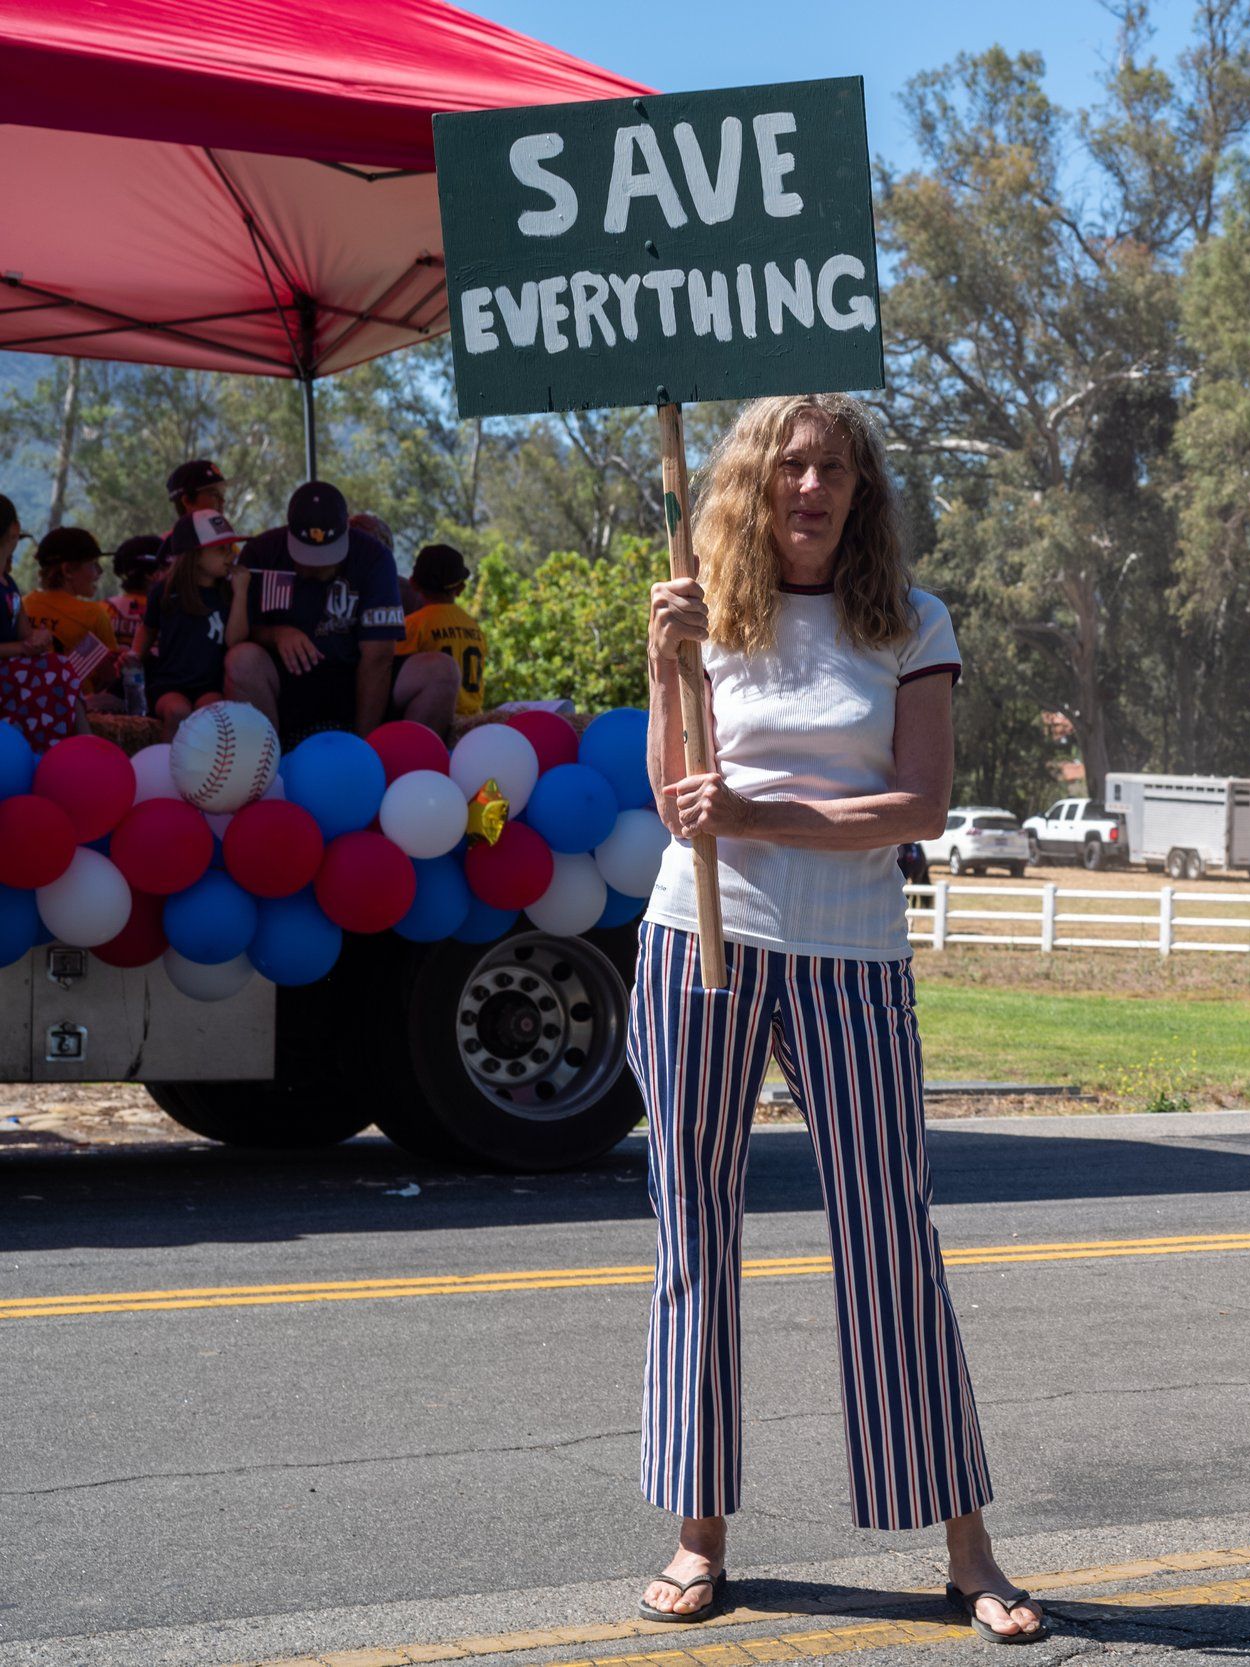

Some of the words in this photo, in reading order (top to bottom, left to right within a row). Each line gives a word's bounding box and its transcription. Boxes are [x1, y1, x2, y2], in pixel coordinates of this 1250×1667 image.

[508, 111, 804, 237] SAVE
[460, 253, 877, 355] EVERYTHING
[441, 644, 483, 694] 0
